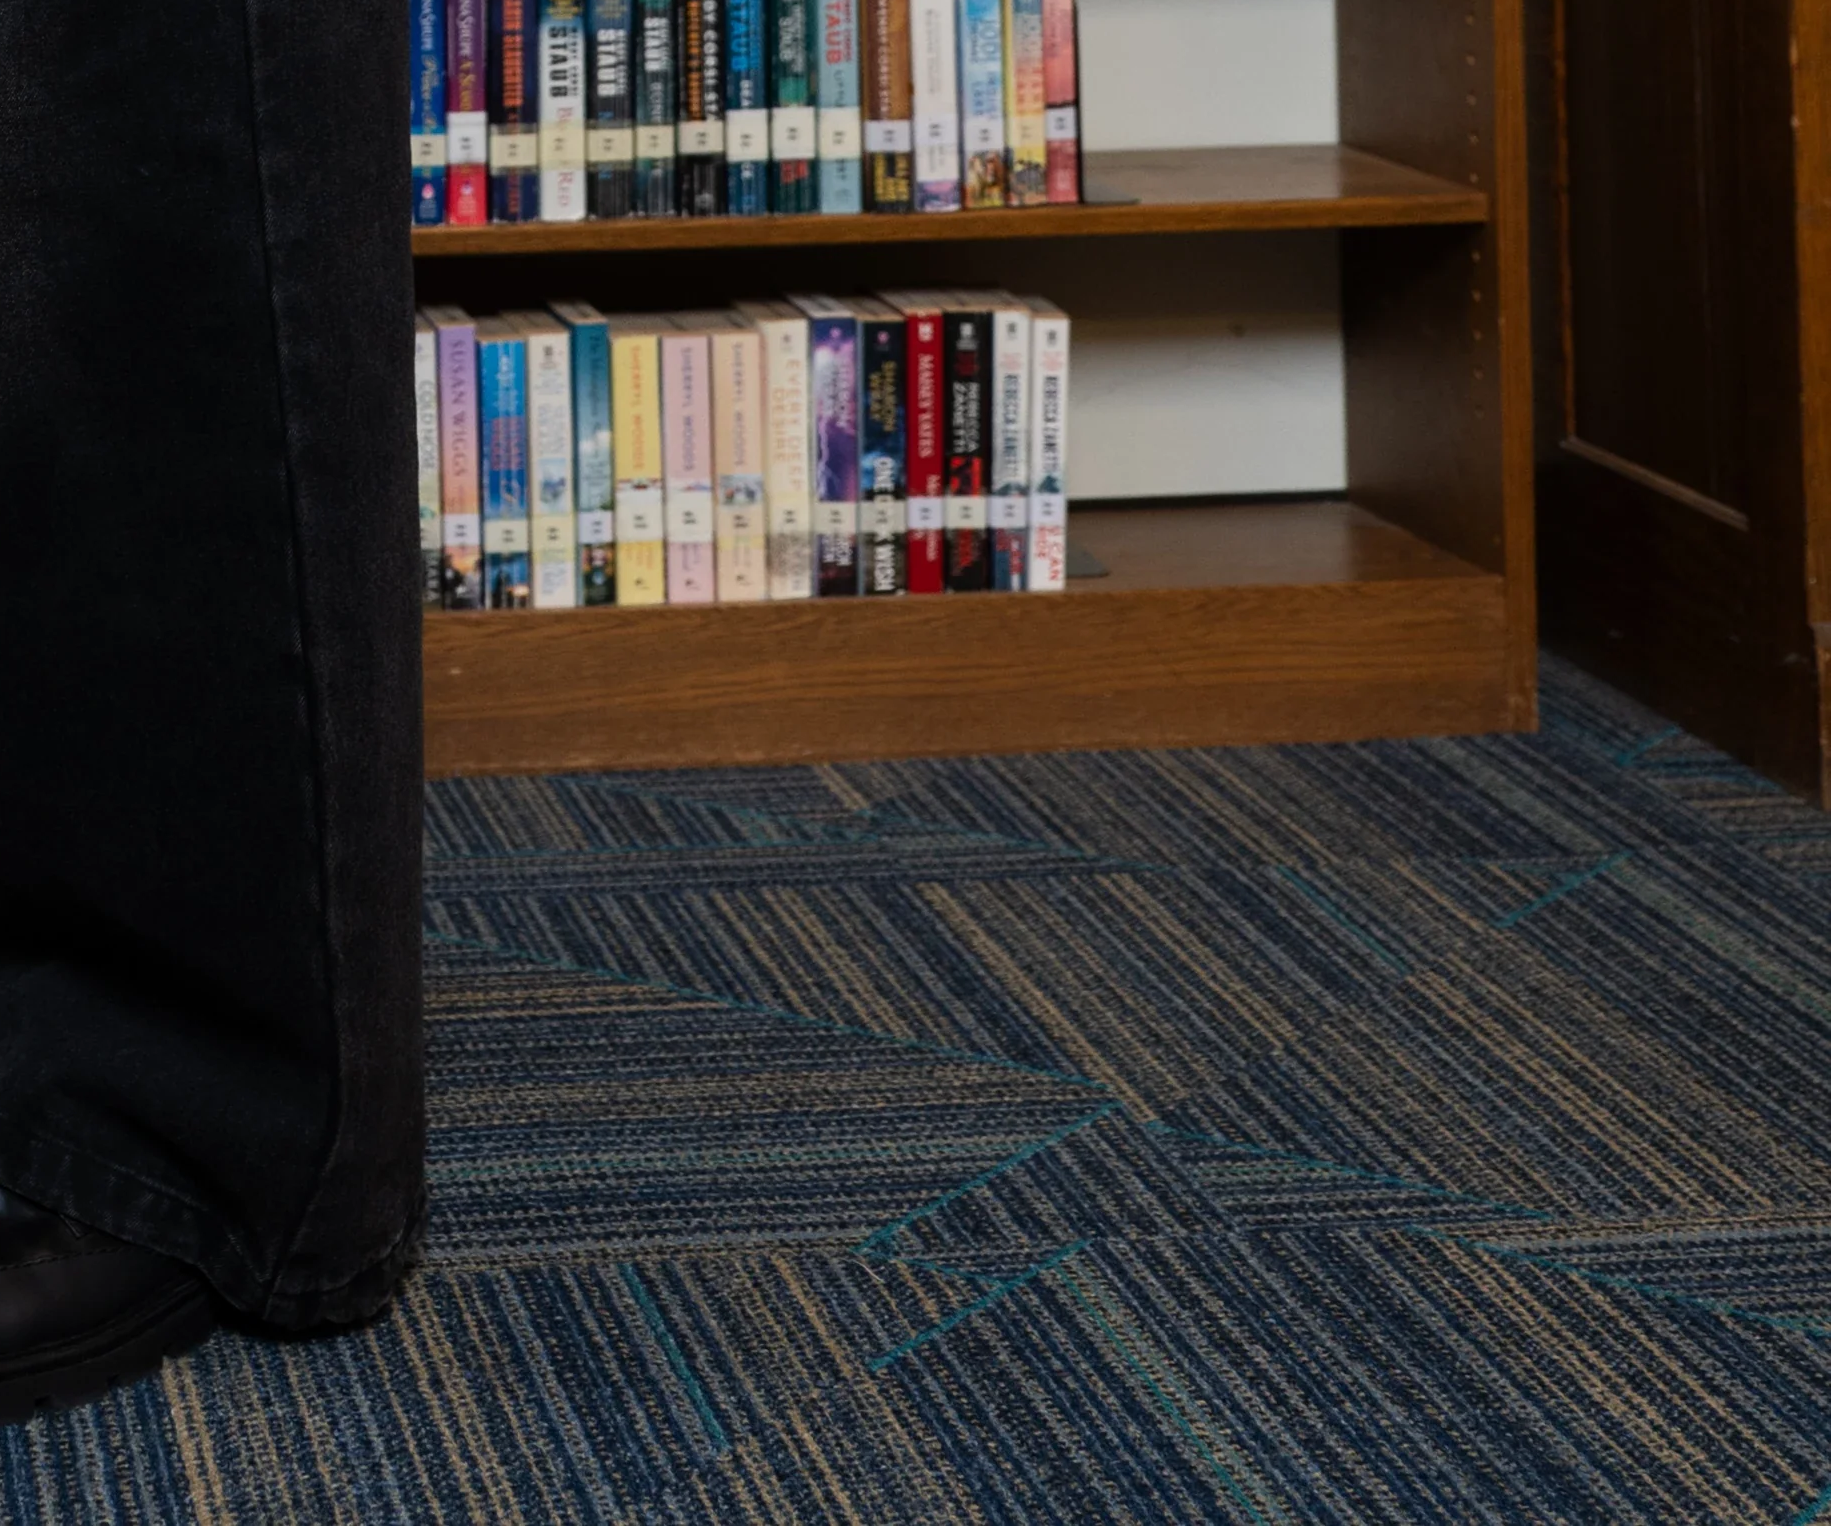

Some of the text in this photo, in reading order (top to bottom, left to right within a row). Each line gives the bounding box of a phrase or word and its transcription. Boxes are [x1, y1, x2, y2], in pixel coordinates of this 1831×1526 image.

[548, 26, 568, 97] STAUB
[597, 29, 615, 95] STAUB
[644, 18, 659, 71] STAUB
[703, 30, 716, 84] CORSI
[780, 17, 793, 61] STAUB
[704, 92, 717, 121] STA
[451, 339, 468, 477] SUSAN WIGGS
[772, 388, 786, 464] DESIRE
[786, 359, 802, 491] EVERY DEEP
[874, 457, 895, 591] ONE WISH
